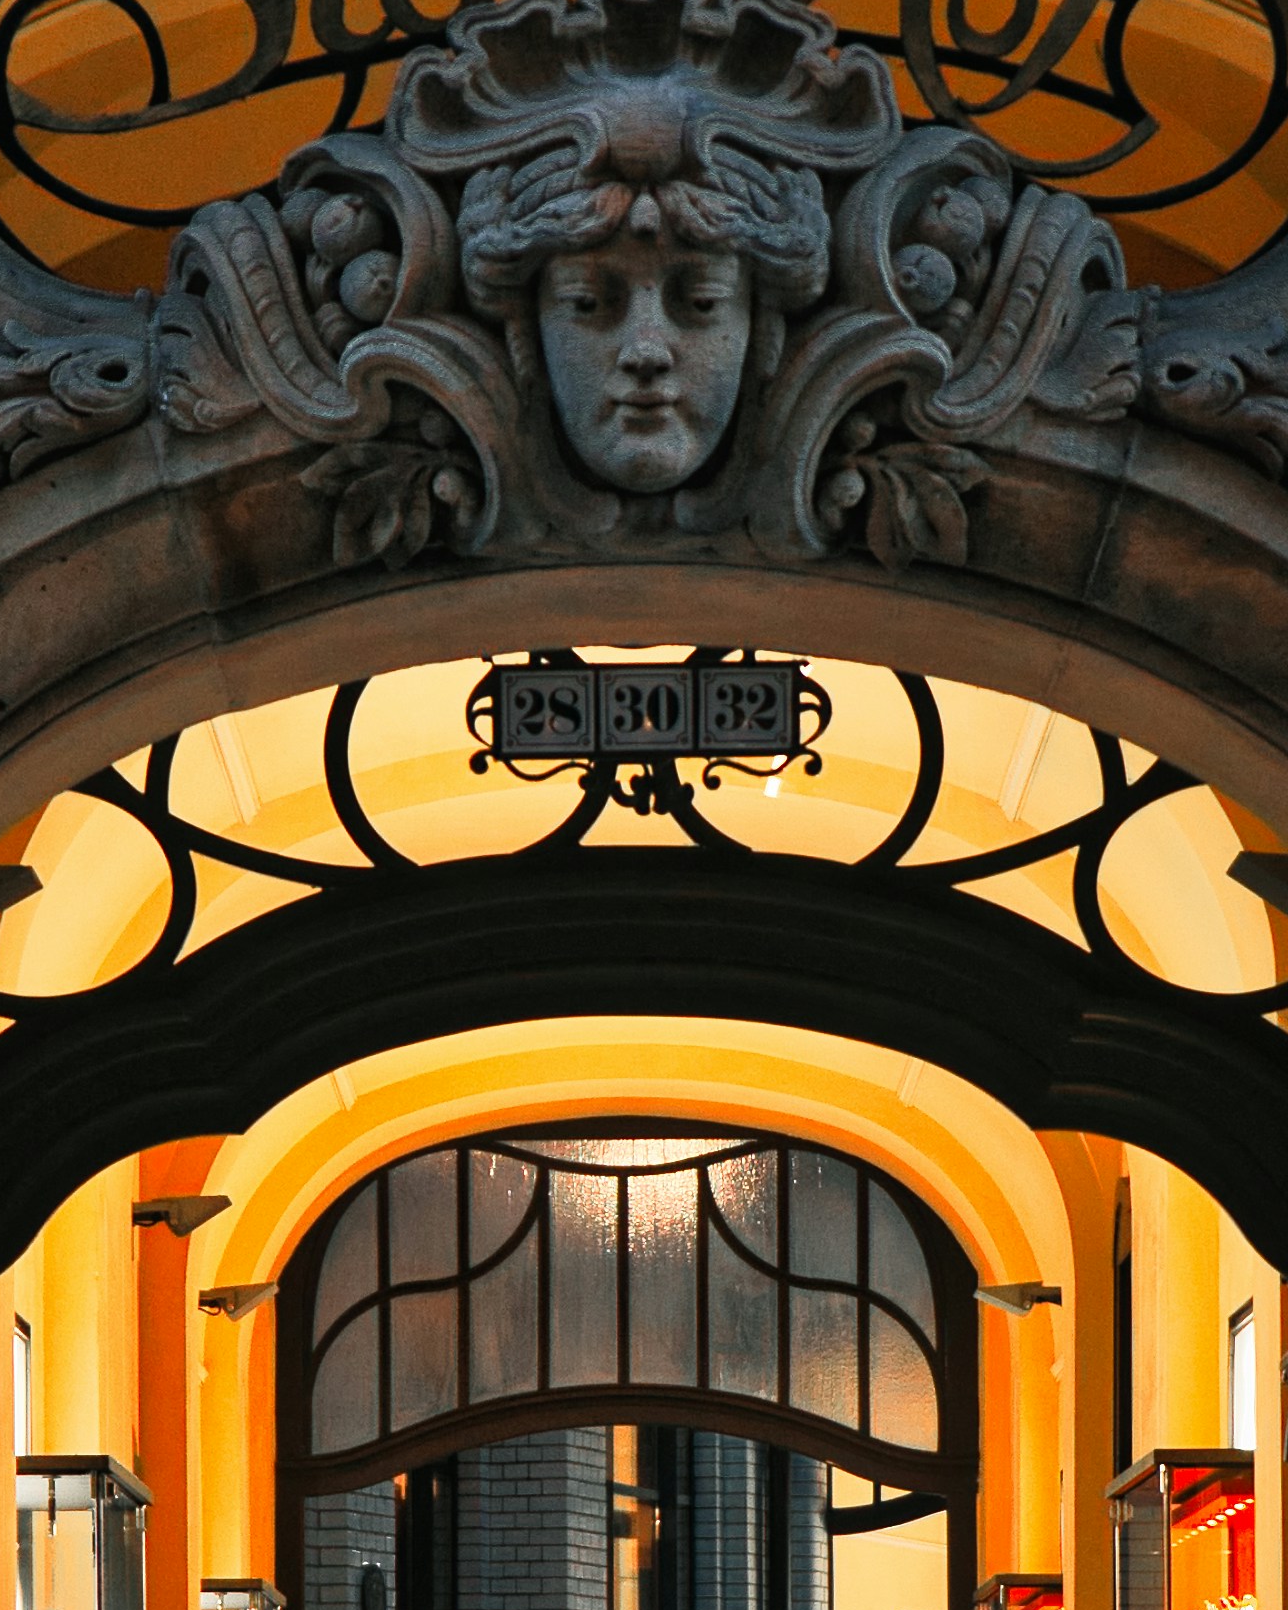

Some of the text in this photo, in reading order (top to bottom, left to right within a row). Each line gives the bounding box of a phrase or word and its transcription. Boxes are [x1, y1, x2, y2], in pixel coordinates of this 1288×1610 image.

[515, 683, 778, 736] 28 30 32
